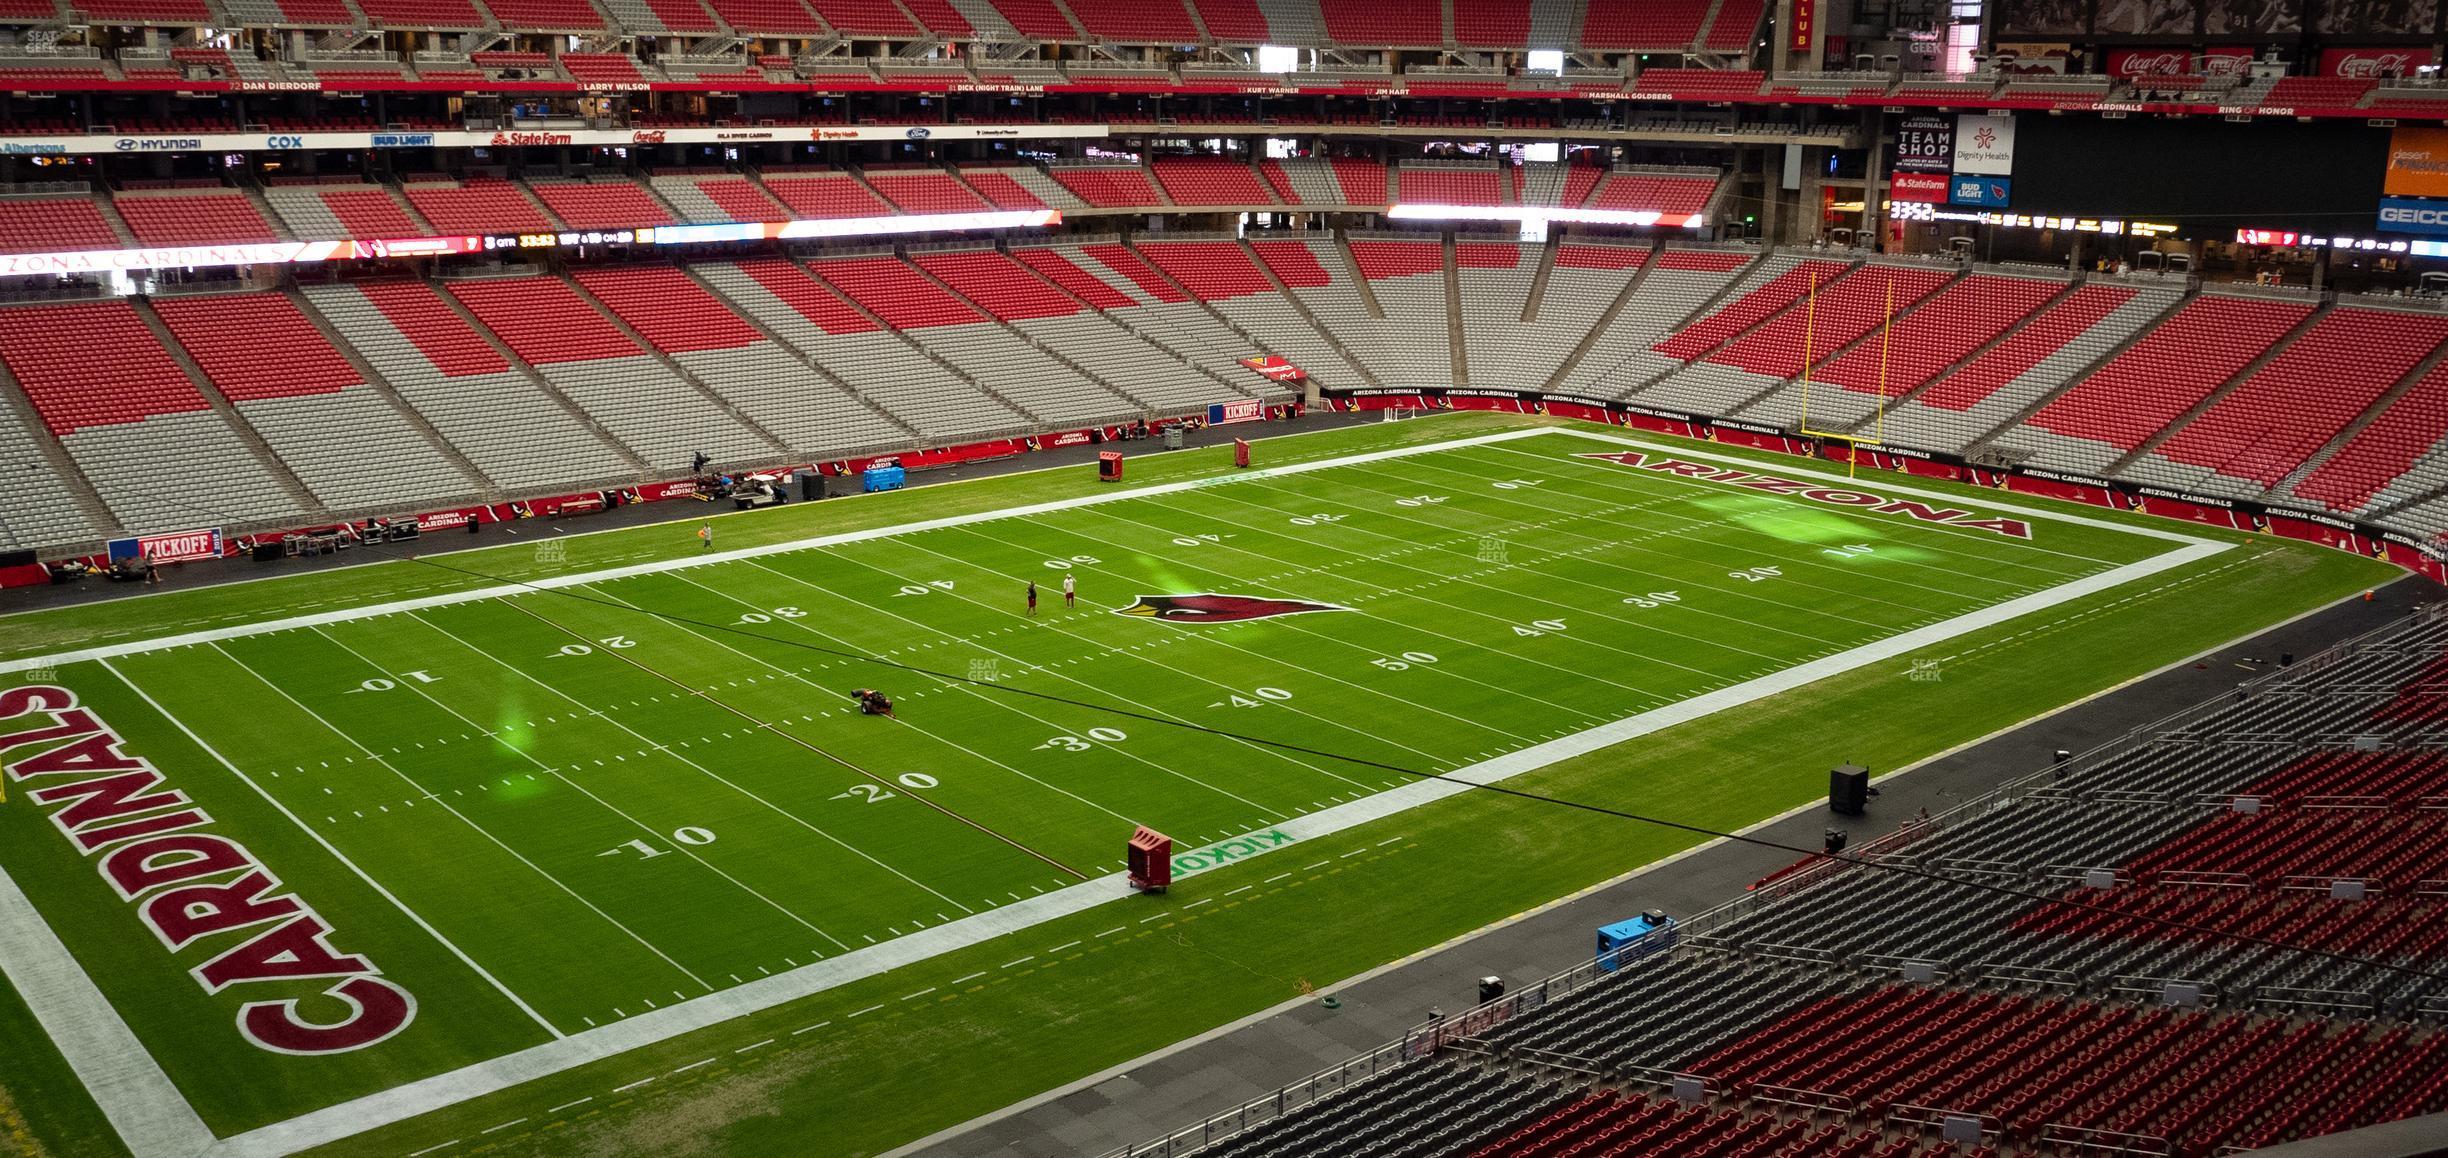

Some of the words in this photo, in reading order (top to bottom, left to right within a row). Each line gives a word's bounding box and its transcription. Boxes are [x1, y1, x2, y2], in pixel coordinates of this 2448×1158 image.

[1798, 0, 1808, 45] LUB
[2122, 53, 2184, 74] Coca-Cola
[242, 82, 266, 90] DAN
[268, 82, 322, 90] DIERDORF
[2091, 103, 2142, 112] CARDINALS
[374, 136, 397, 146] BUD
[399, 136, 432, 146] LIGHT
[634, 130, 665, 144] Coca-Cola
[910, 128, 928, 138] Ford
[1900, 132, 1950, 144] TEAM
[5, 143, 66, 153] Albertsons
[141, 139, 201, 150] HYUNDAI
[268, 136, 302, 148] COX
[1898, 144, 1948, 156] SHOP
[1957, 151, 1984, 161] Dignity
[1985, 152, 2009, 160] Health
[2393, 148, 2430, 159] desert
[1957, 190, 1983, 198] LIGHT
[1961, 183, 1980, 191] BUD
[1890, 201, 1932, 220] 33:52
[466, 238, 478, 250] 7
[497, 238, 516, 248] QTR
[112, 248, 284, 268] CARDINALS
[1542, 394, 1571, 402] ARIZONA
[1573, 397, 1606, 407] CARDINALS
[1225, 402, 1258, 420] KICKOFF
[1626, 406, 1653, 415] ARIZONA
[1655, 411, 1690, 421] CARDINALS
[1711, 419, 1740, 428] ARIZONA
[1741, 423, 1779, 435] CARDINALS
[1054, 436, 1089, 445] CARDINALS
[1855, 442, 1886, 452] ARIZONA
[1888, 447, 1930, 459] CARDINALS
[1492, 479, 1537, 490] 10
[2023, 468, 2059, 480] ARIZONA
[2061, 474, 2110, 487] CARDINALS
[1395, 495, 1441, 507] 20
[1568, 450, 2033, 540] ARIZONA
[2139, 487, 2178, 499] ARIZONA
[2181, 494, 2232, 507] CARDINALS
[418, 516, 468, 530] CARDINALS
[428, 512, 460, 521] ARIZONA
[1289, 512, 1341, 527] 30
[2265, 507, 2308, 520] ARIZONA
[2310, 514, 2355, 530] CARDINALS
[144, 534, 208, 559] KICKOFF
[1172, 533, 1221, 548] 40
[2382, 532, 2415, 547] ARIZONA
[1822, 544, 1874, 560] 10
[1043, 554, 1102, 571] 50
[1729, 567, 1782, 583] 20
[900, 580, 955, 596] 40
[1623, 591, 1682, 609] 30
[741, 606, 808, 625] 30
[1512, 618, 1567, 638] 40
[560, 635, 637, 657] 20
[1370, 650, 1438, 672] 50
[362, 669, 443, 690] 10
[1230, 686, 1292, 709] 40
[1047, 726, 1128, 752] 30
[848, 772, 938, 804] 20
[618, 826, 716, 860] 10
[0, 684, 418, 1056] CARDINALS
